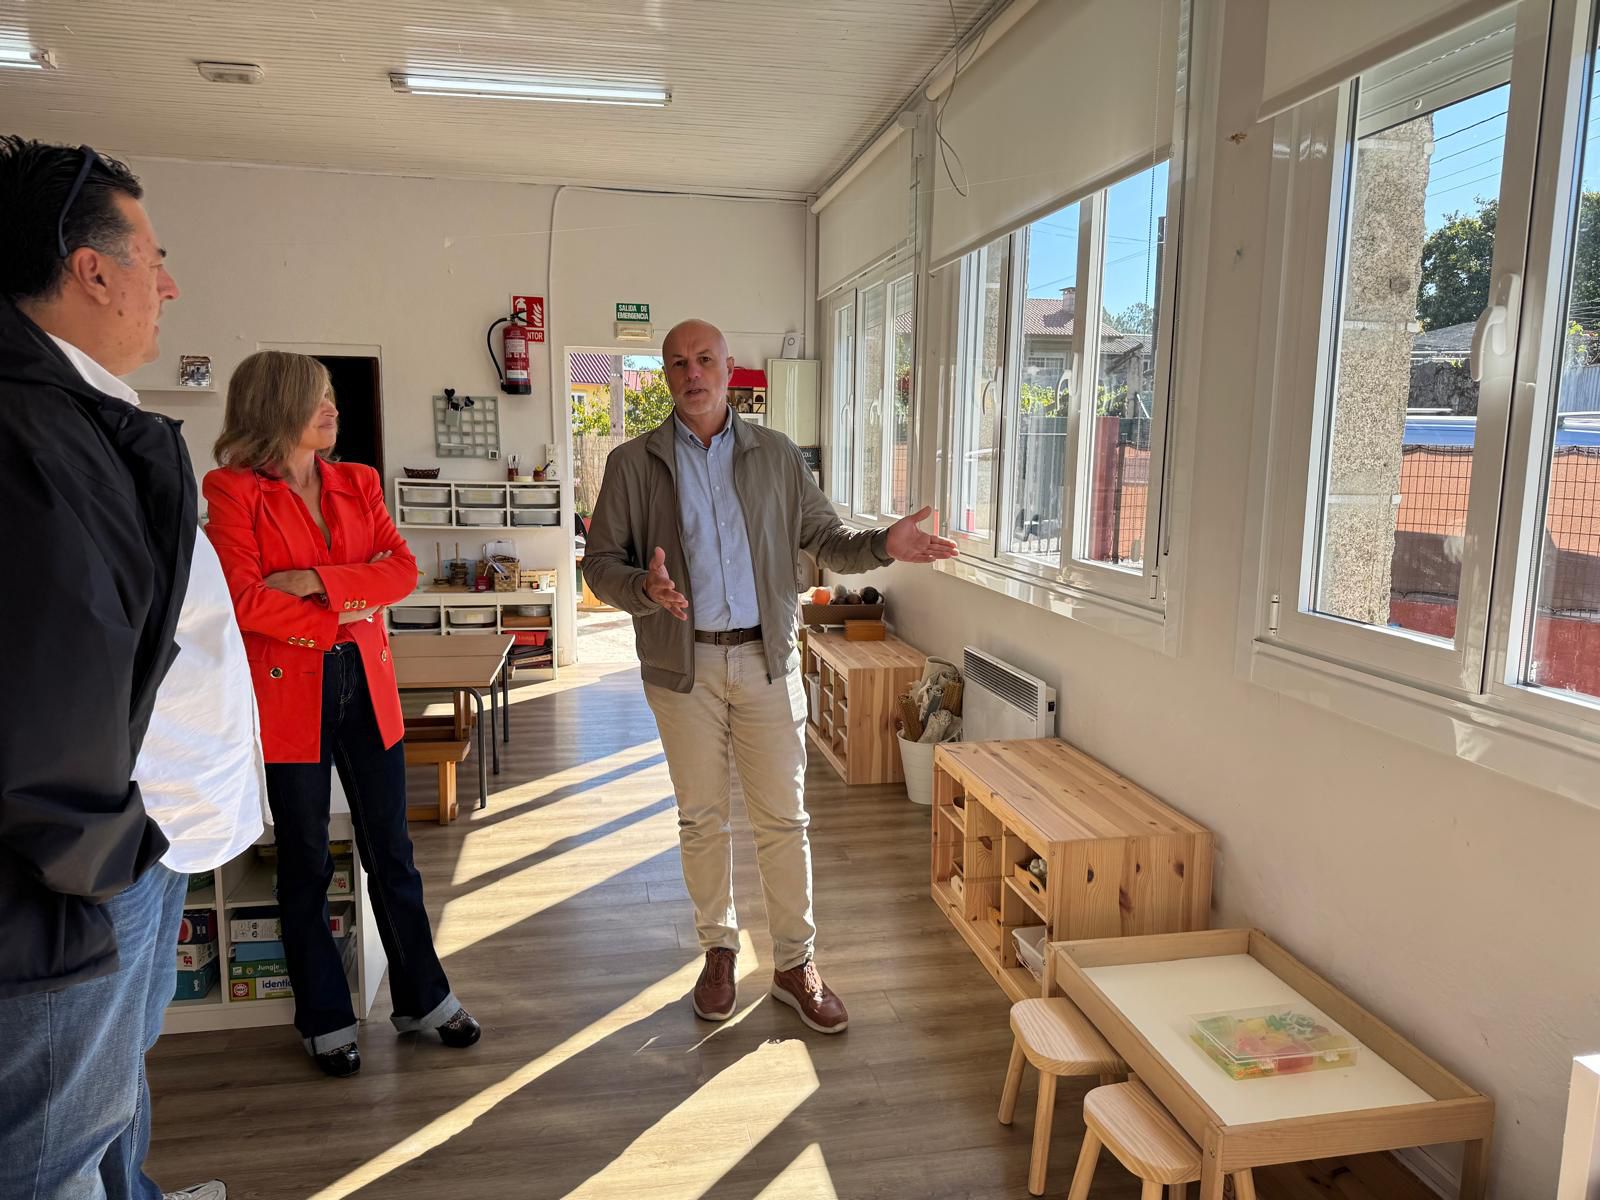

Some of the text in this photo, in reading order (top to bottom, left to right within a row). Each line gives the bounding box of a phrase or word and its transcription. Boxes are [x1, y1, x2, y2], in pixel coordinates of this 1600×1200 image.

[618, 304, 637, 312] SALIDA
[617, 312, 649, 320] EMERGENCIA
[527, 332, 543, 340] NTOR
